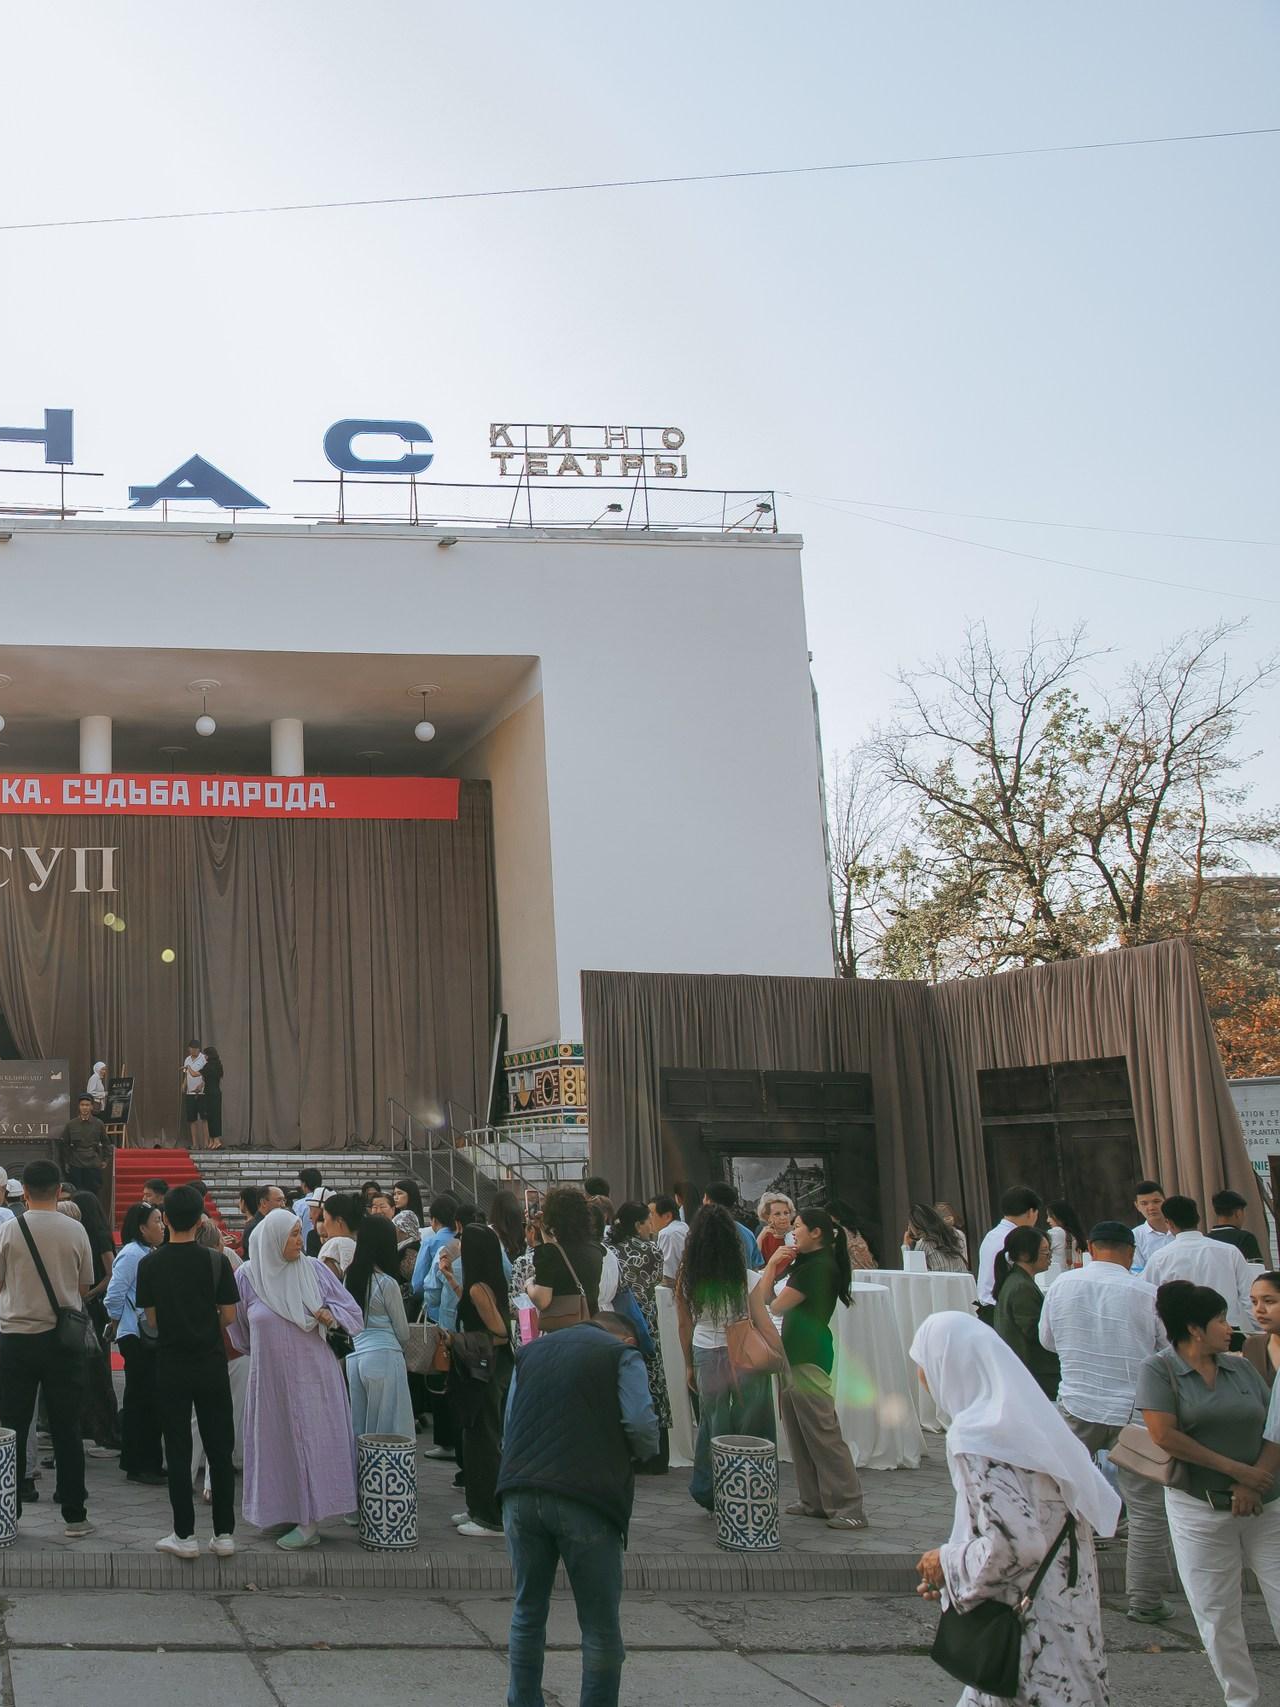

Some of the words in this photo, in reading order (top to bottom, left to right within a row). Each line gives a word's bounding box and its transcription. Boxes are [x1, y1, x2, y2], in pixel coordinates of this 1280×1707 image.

[489, 423, 686, 451] КИНО
[489, 451, 688, 479] ТЕАТРЫ
[62, 778, 191, 808] СУДЬБА
[200, 780, 336, 812] НАРОДА.
[1240, 1119, 1280, 1127] SPACE
